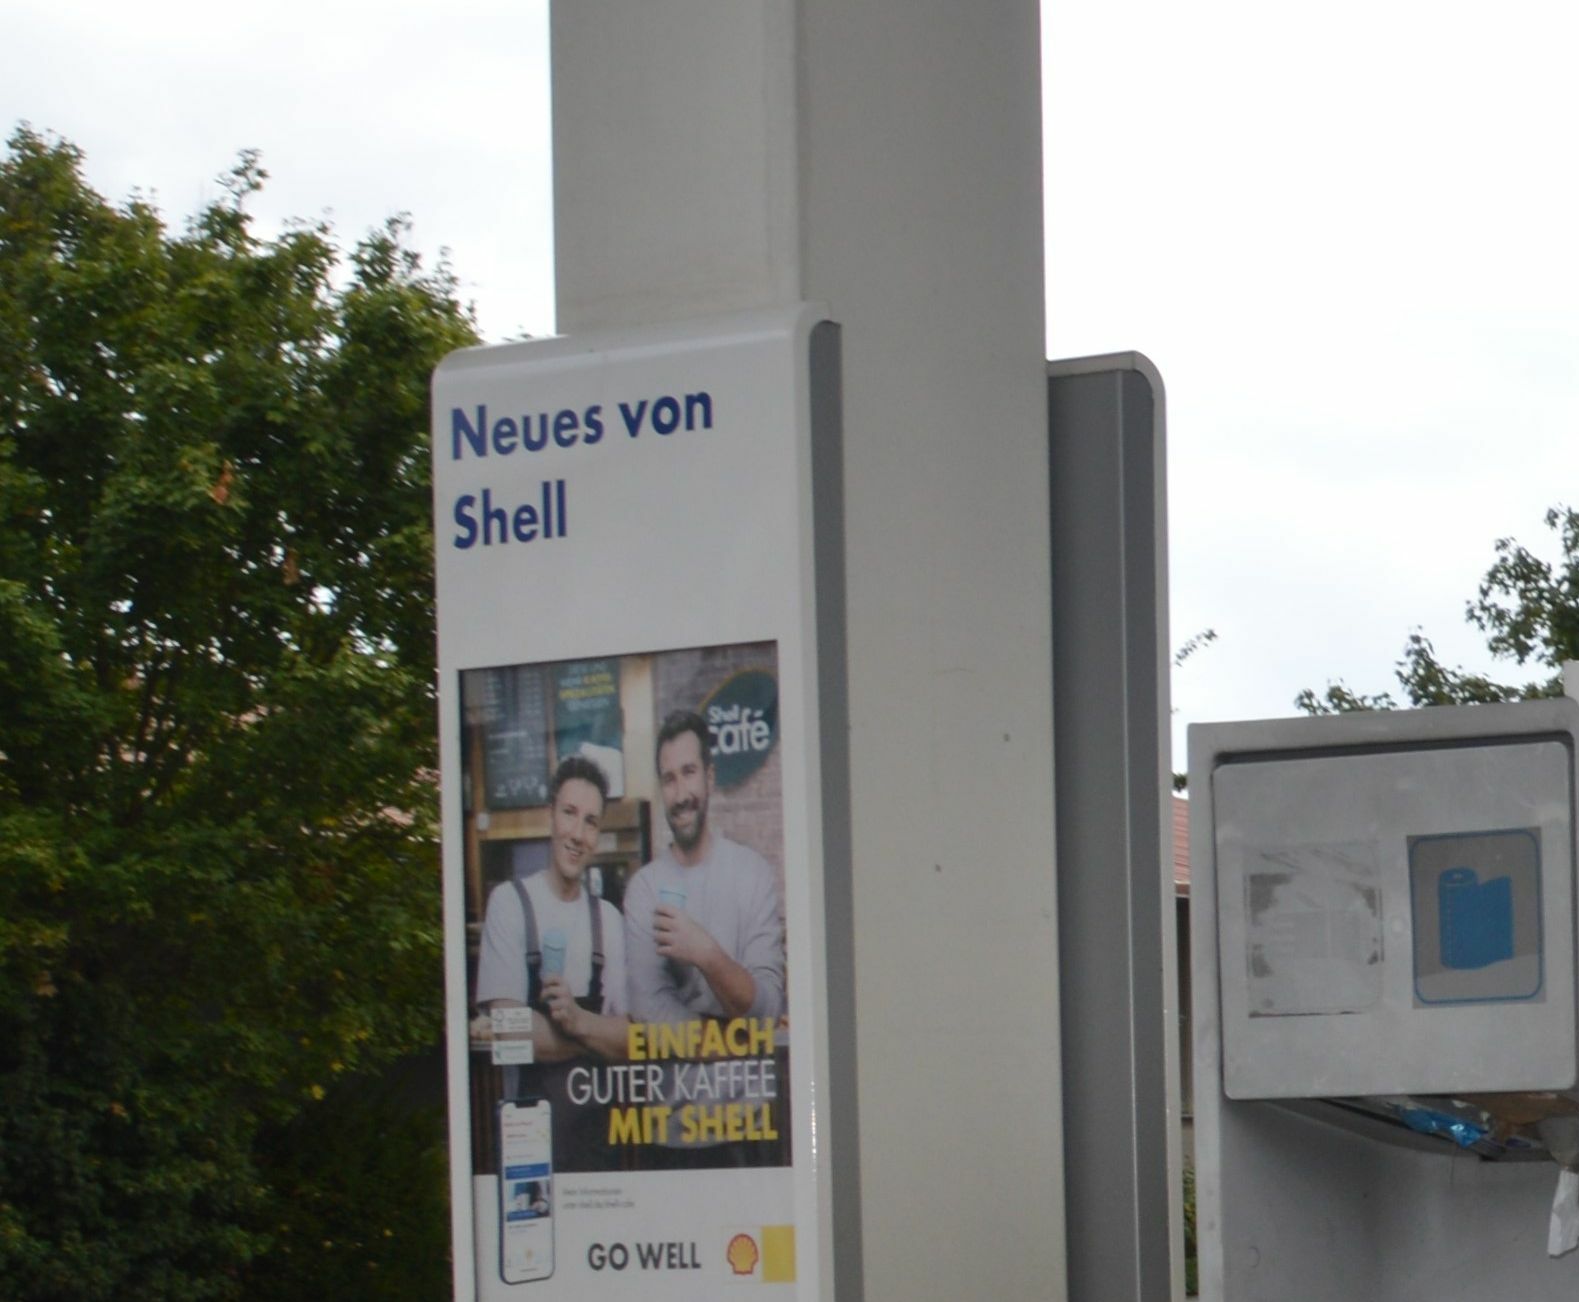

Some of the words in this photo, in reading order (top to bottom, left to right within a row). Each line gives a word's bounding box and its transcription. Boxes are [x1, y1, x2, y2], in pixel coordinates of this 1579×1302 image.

[451, 404, 604, 461] Neues
[617, 391, 713, 439] von
[453, 478, 567, 550] Shell
[627, 1016, 775, 1061] EINFACH
[567, 1064, 664, 1105] GUTER
[672, 1060, 777, 1100] KAFFEE
[608, 1106, 673, 1145] MIT
[680, 1103, 778, 1142] SHELL
[587, 1243, 629, 1271] GO
[635, 1242, 702, 1270] WELL
